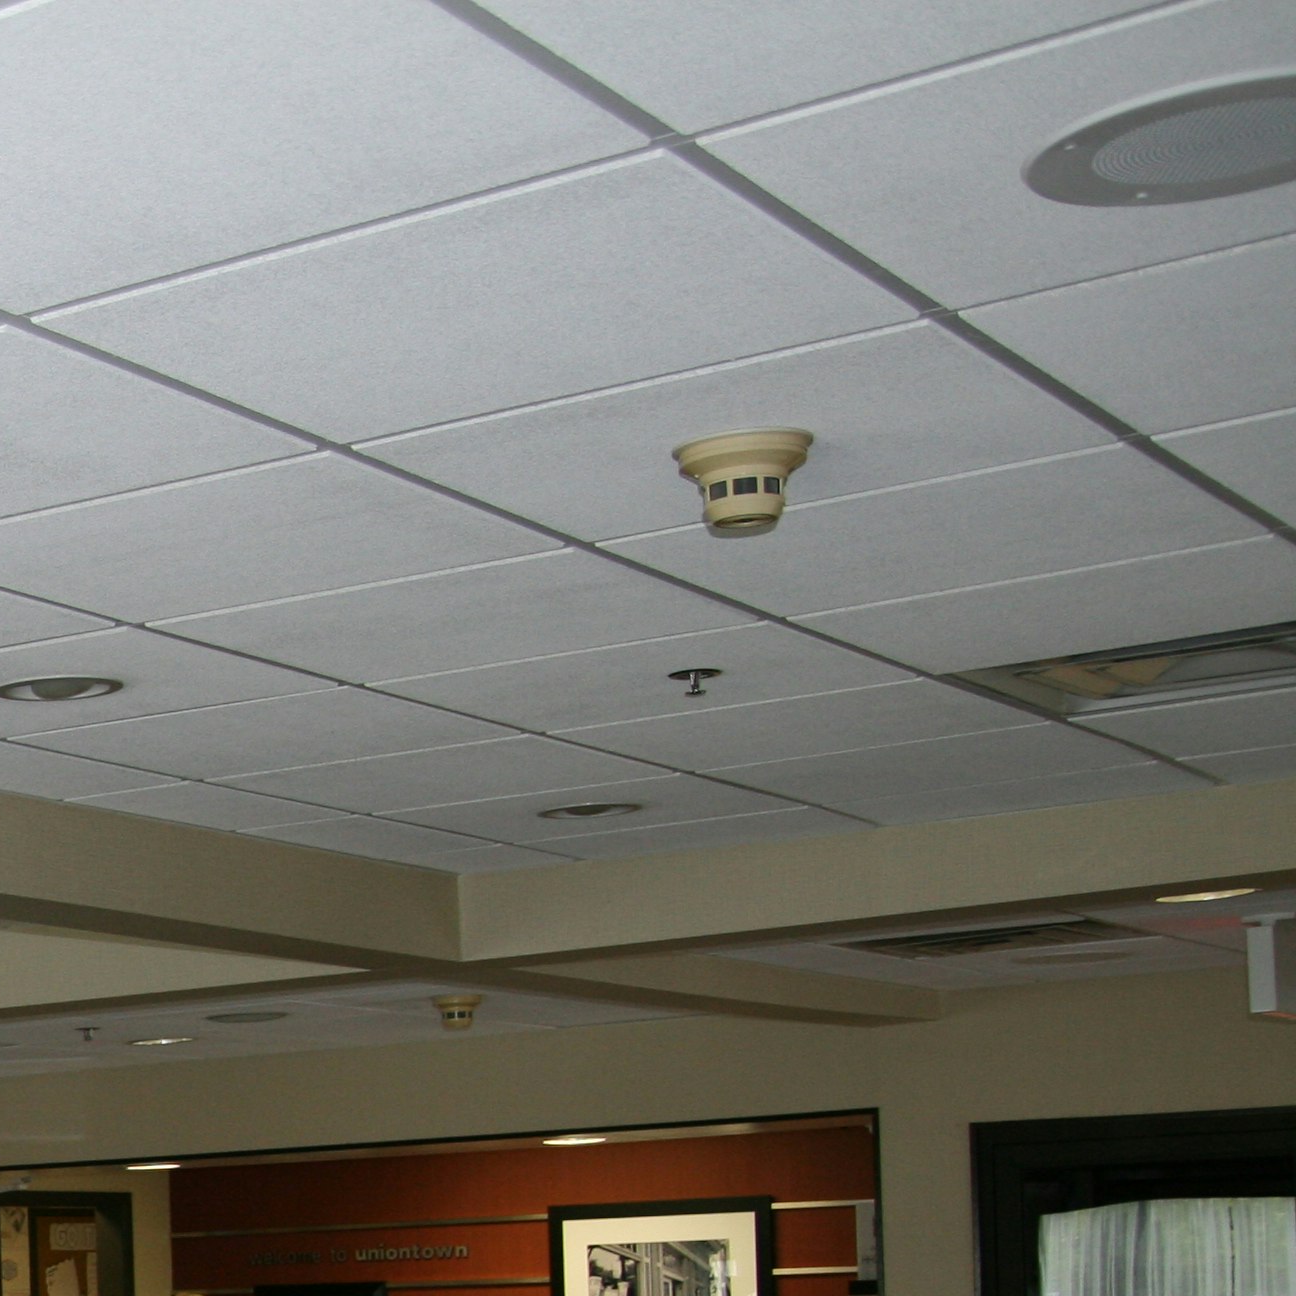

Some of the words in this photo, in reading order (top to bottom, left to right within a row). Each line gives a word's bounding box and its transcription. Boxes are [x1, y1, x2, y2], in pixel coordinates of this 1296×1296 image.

[249, 1249, 321, 1265] welcome
[330, 1247, 348, 1263] to
[355, 1243, 470, 1262] uniontown
